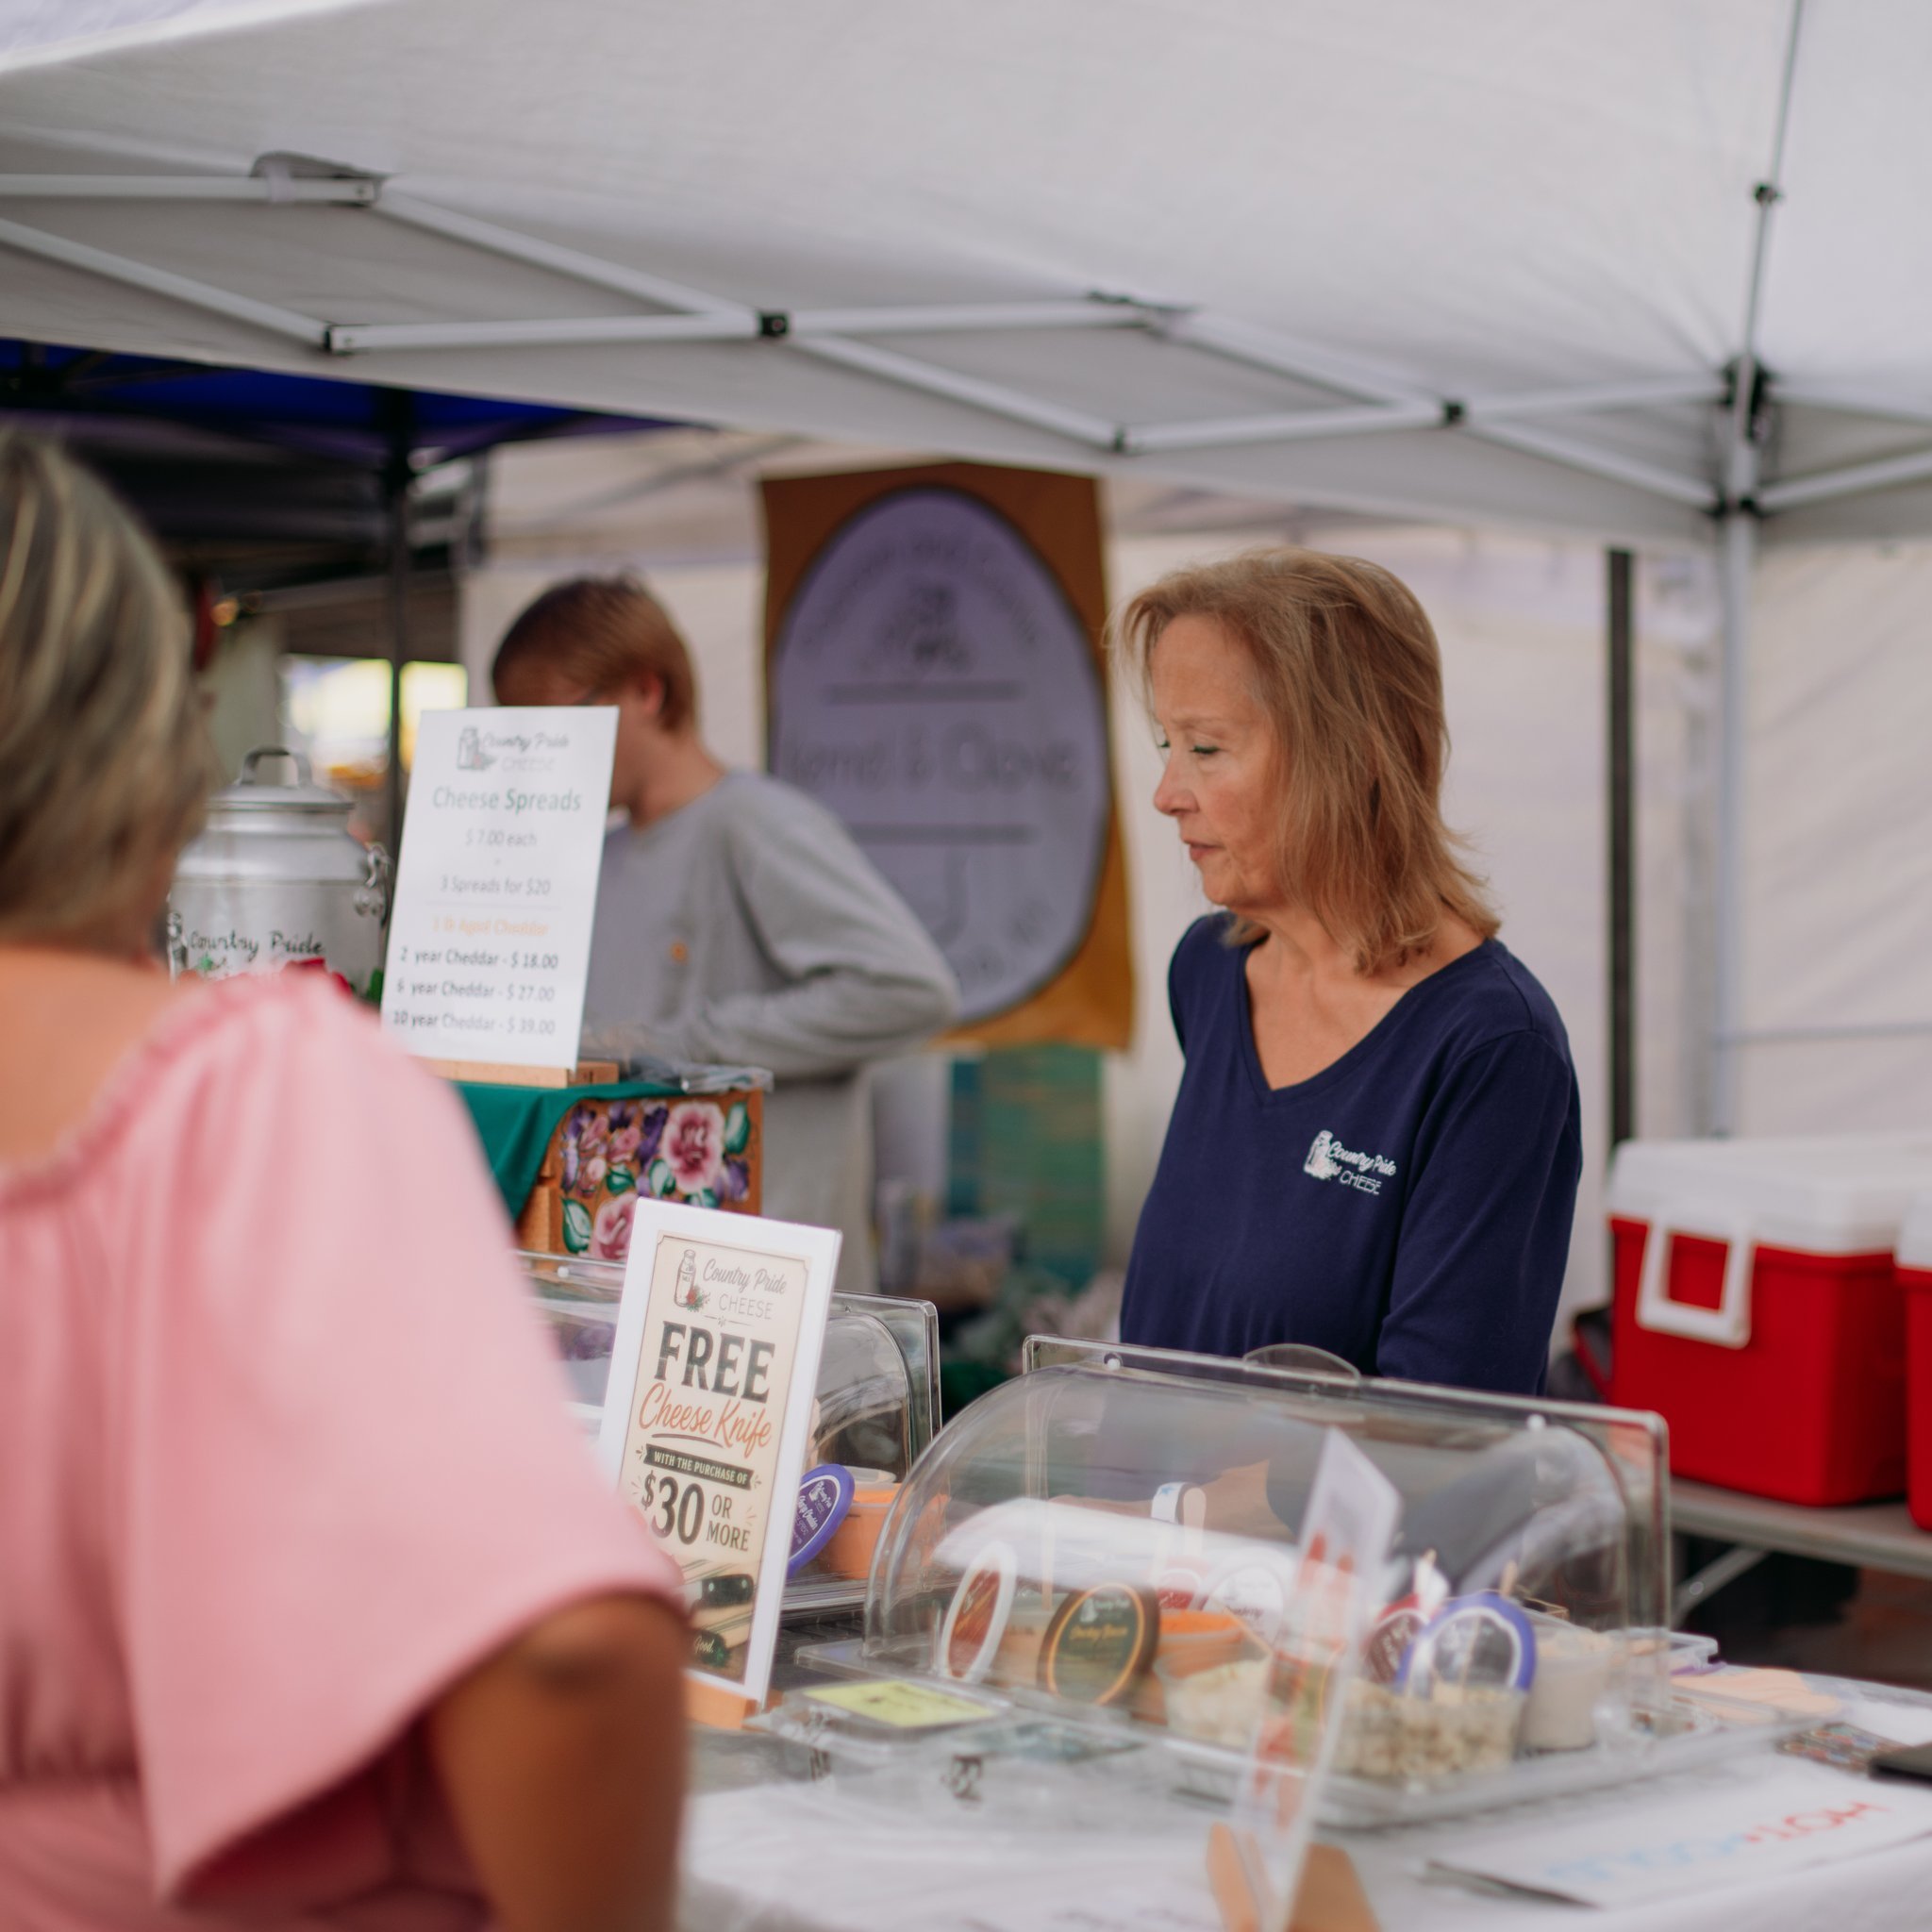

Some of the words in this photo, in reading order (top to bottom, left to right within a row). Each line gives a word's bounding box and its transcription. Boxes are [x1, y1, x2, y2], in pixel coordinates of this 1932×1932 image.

[432, 786, 500, 809] Cheese
[504, 788, 582, 815] Spreads
[507, 832, 539, 846] each
[441, 874, 449, 892] 3
[452, 874, 501, 894] Spreads
[504, 876, 523, 893] for
[525, 877, 552, 895] $20
[494, 920, 549, 936] Cheddar
[191, 929, 259, 962] Country
[270, 929, 325, 955] Pride
[400, 946, 408, 962] 2
[414, 951, 441, 965] year
[446, 948, 499, 966] Cheddar
[411, 983, 438, 997] year
[441, 980, 494, 998] Cheddar
[392, 1010, 409, 1026] 10
[411, 1015, 439, 1028] year
[441, 1012, 495, 1032] Cheddar
[1328, 1141, 1374, 1172] Country
[1373, 1155, 1396, 1176] Pride
[1340, 1170, 1382, 1195] CHEESE
[702, 1257, 751, 1293] Country
[753, 1268, 788, 1295] Pride
[718, 1293, 774, 1320] CHEESE
[654, 1320, 775, 1404] FREE
[639, 1382, 713, 1434] Cheese
[713, 1398, 772, 1458] Knife
[654, 1451, 675, 1466] WITH
[677, 1457, 692, 1471] THE
[693, 1461, 736, 1482] PURCHASE
[737, 1473, 748, 1485] OF
[641, 1470, 705, 1545] $30
[711, 1494, 732, 1519] OR
[706, 1520, 751, 1552] MORE
